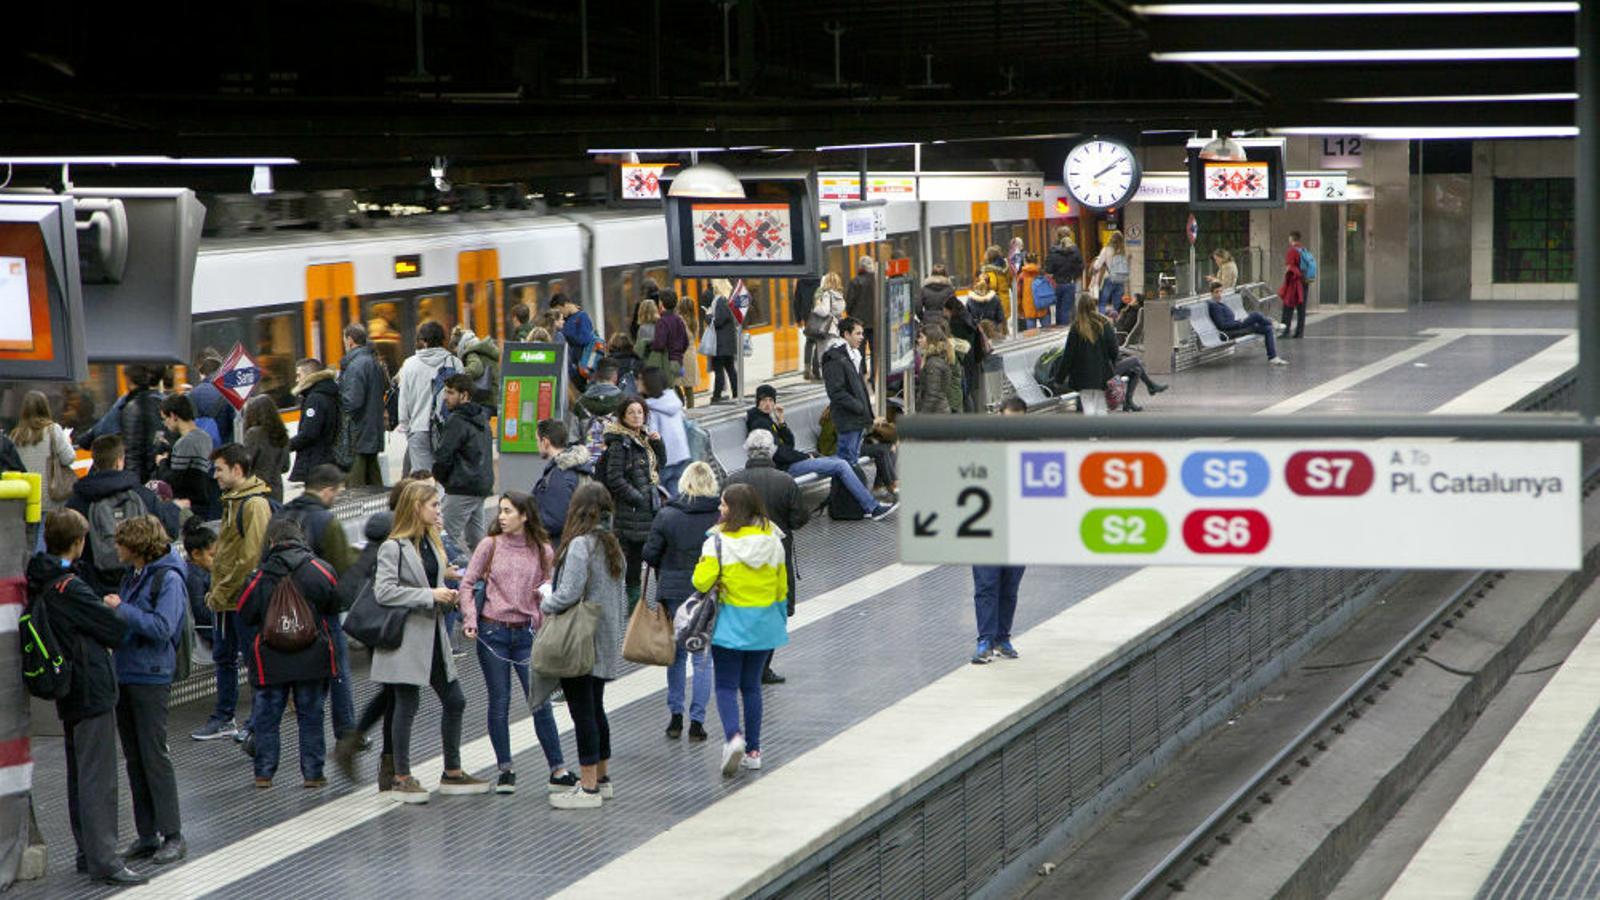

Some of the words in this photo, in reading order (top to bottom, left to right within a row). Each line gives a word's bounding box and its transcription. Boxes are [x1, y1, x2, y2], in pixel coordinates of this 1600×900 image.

[1323, 137, 1361, 156] L12
[1326, 186, 1335, 198] 2
[1390, 451, 1404, 465] A
[1411, 450, 1431, 465] To
[958, 462, 988, 479] via
[1023, 460, 1064, 489] L6
[1103, 457, 1145, 489] S1
[1202, 458, 1248, 489] S5
[1304, 457, 1353, 489] S7
[1391, 472, 1422, 493] Pl.
[1430, 472, 1562, 498] Catalunya
[956, 485, 993, 539] 2
[1102, 515, 1147, 545] S2
[1202, 516, 1251, 547] S6
